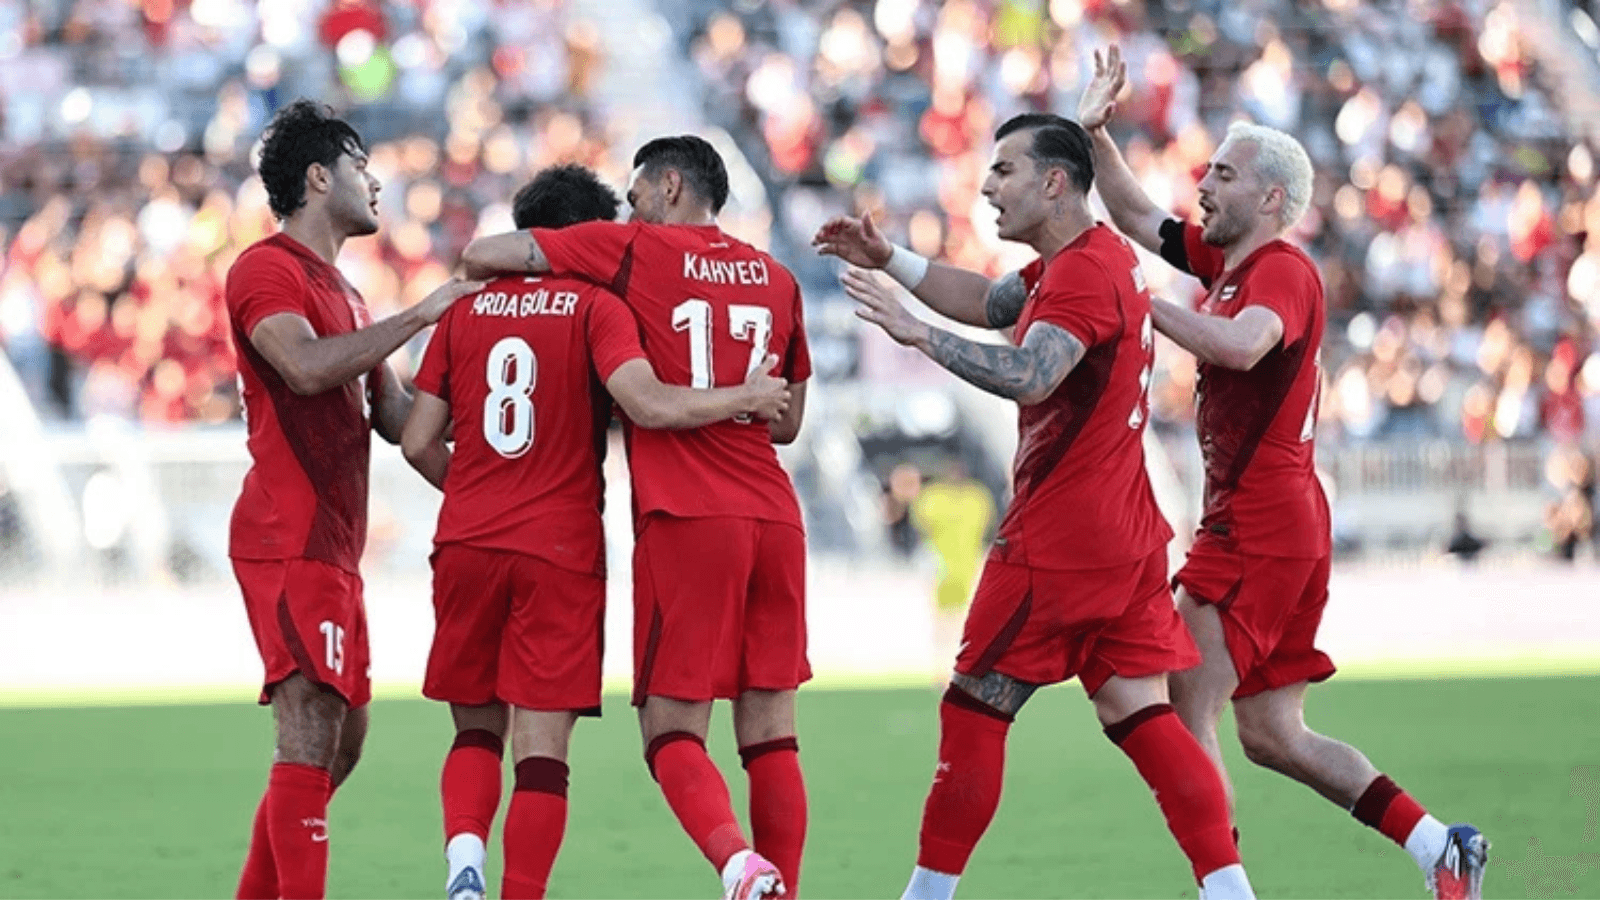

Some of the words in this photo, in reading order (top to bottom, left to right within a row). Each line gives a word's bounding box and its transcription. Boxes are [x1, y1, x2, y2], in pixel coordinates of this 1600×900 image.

[470, 291, 519, 318] ARDA
[520, 287, 579, 317] GÜLER
[483, 336, 538, 460] 8
[319, 620, 345, 677] 15
